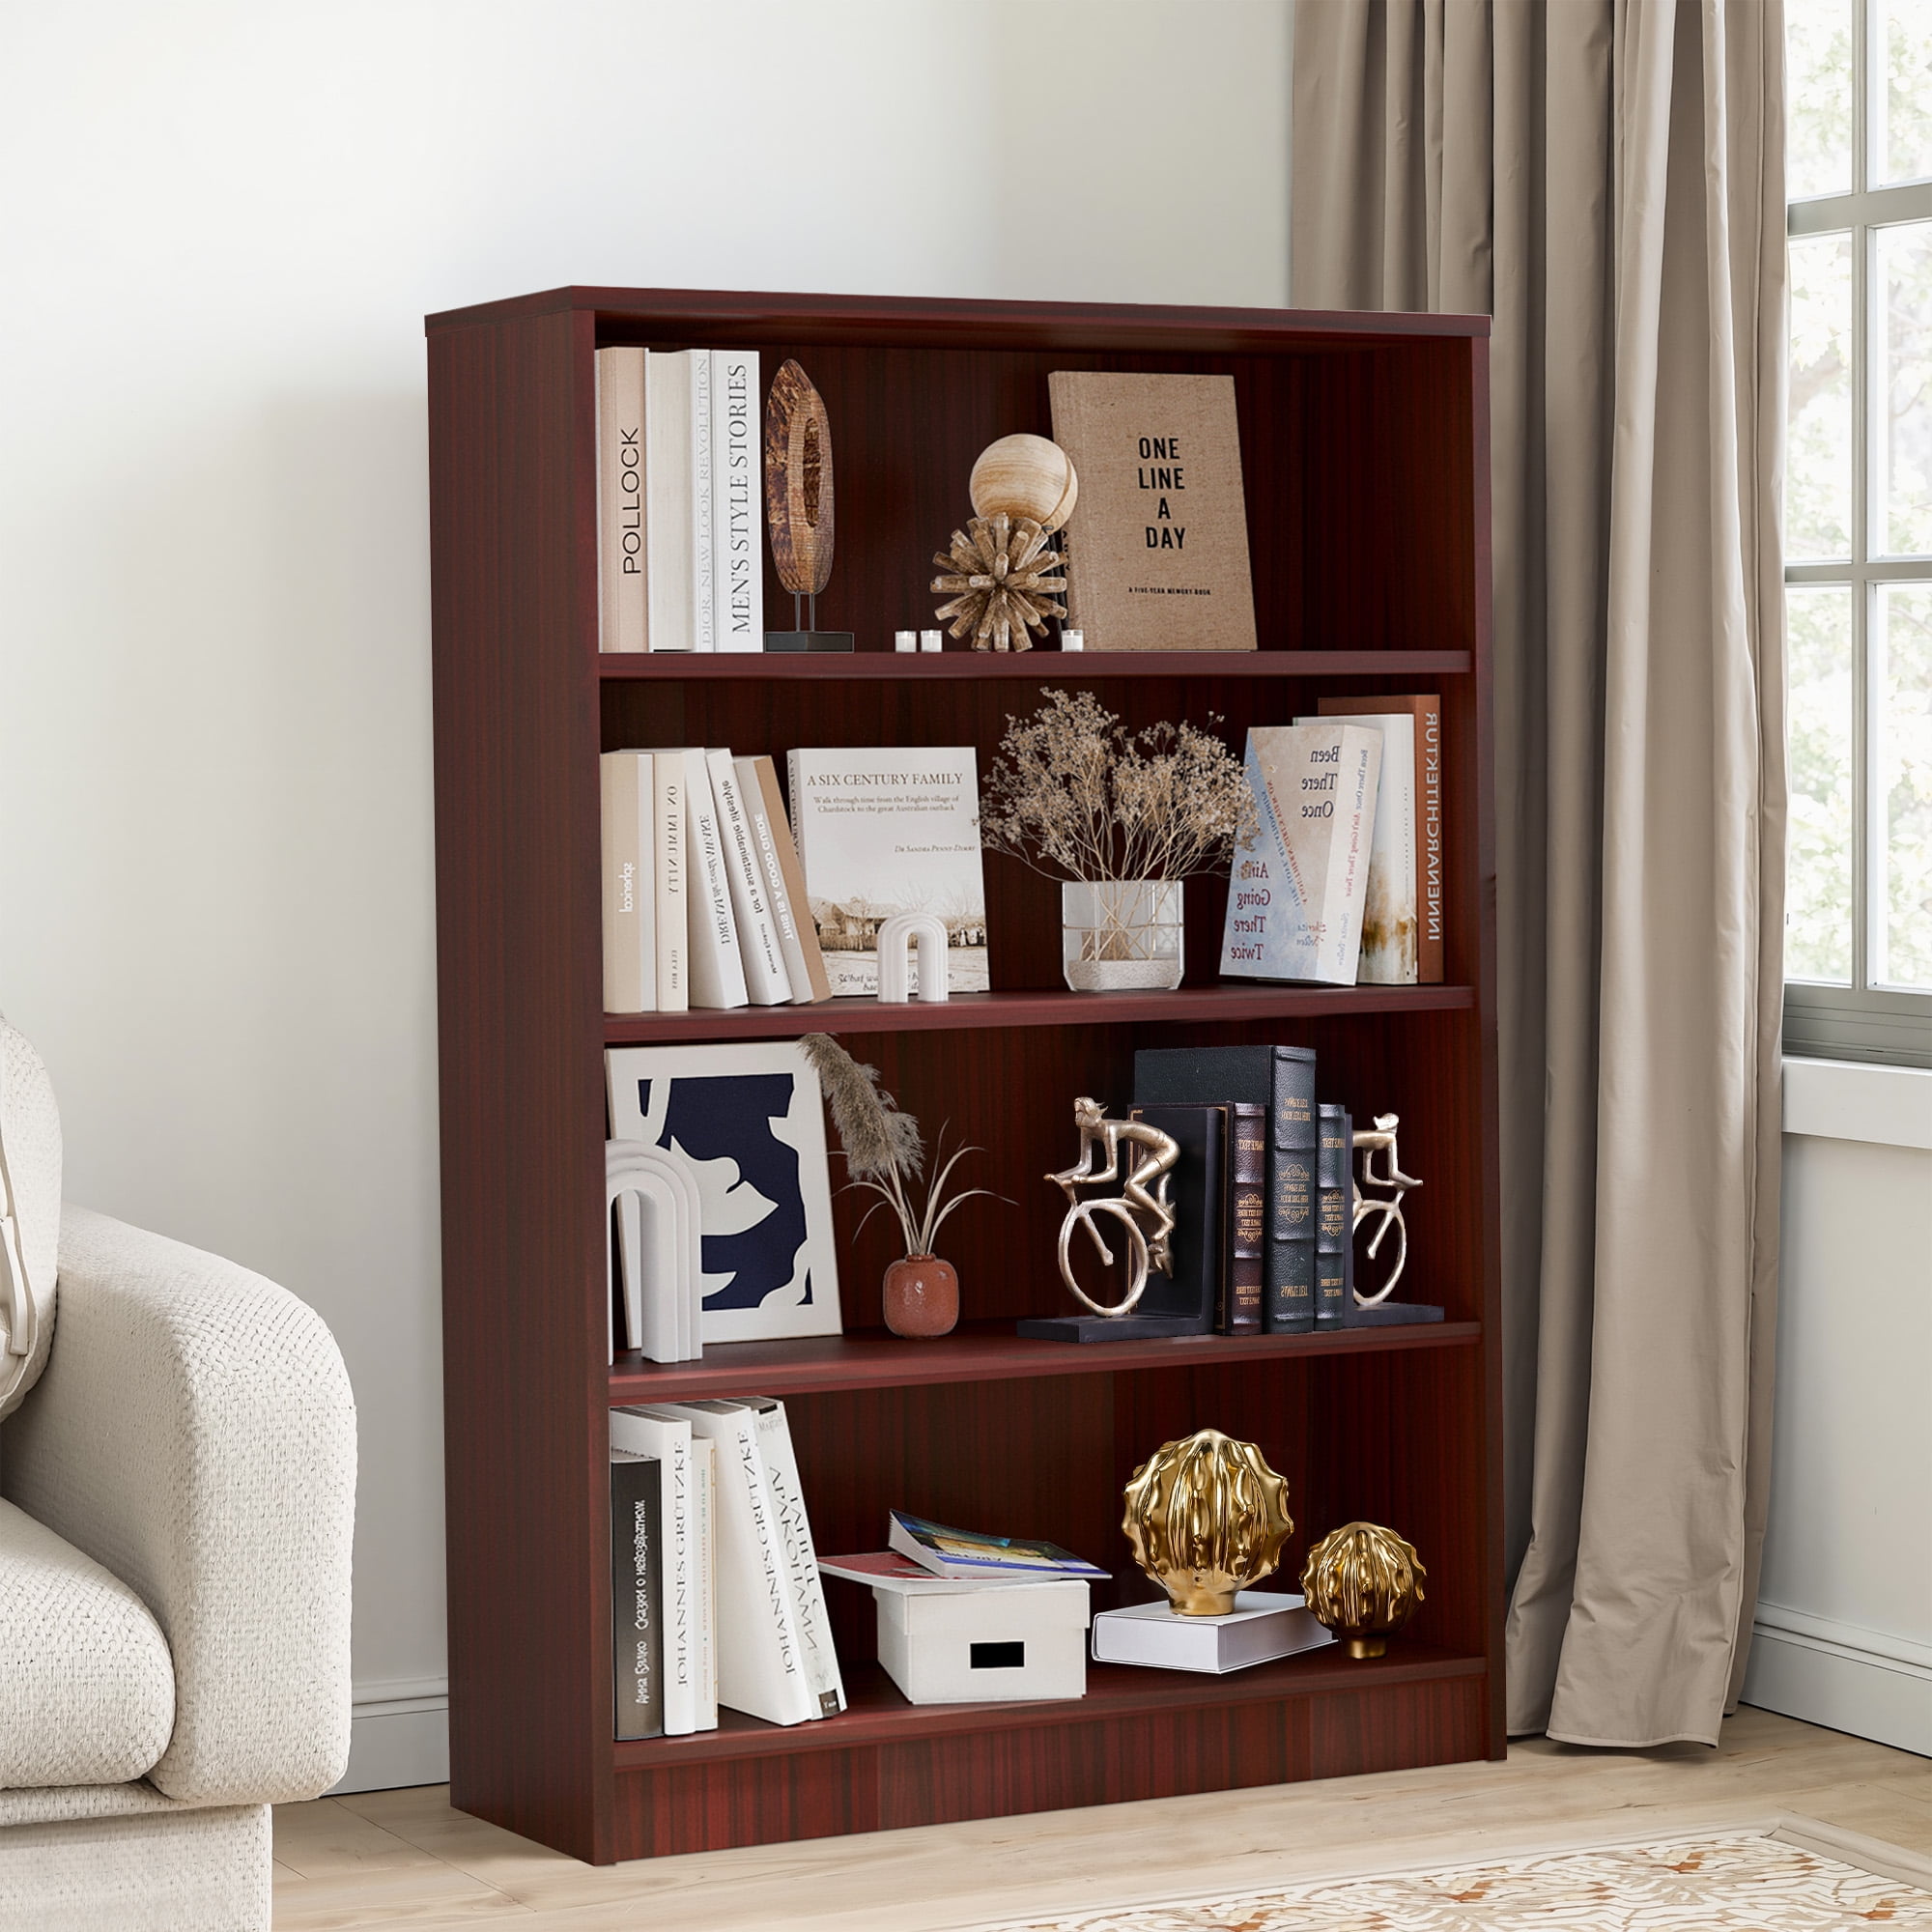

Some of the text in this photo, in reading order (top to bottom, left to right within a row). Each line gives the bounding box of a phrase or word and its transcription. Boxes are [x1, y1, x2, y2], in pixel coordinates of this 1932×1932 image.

[697, 358, 709, 480] REVOLUTION
[1138, 438, 1180, 460] ONE
[727, 364, 750, 633] MEN'S STYLE STORIES
[1138, 468, 1185, 490] LINE
[621, 428, 641, 574] POLLOCK
[699, 486, 710, 539] LOOK
[1157, 497, 1171, 519] A
[1145, 526, 1186, 550] DAY
[700, 547, 711, 587] NEW
[807, 773, 963, 786] A SIX CENTURY FAMILY
[833, 795, 859, 805] through
[876, 795, 893, 804] from
[906, 795, 929, 805] English
[930, 795, 951, 805] village
[895, 804, 928, 812] Australian
[636, 1577, 646, 1586] о
[634, 1589, 649, 1630] Сказки
[676, 1561, 688, 1687] JOHANNES
[762, 1548, 796, 1675] JOHANNES
[635, 1640, 649, 1704] Анна Бялко
